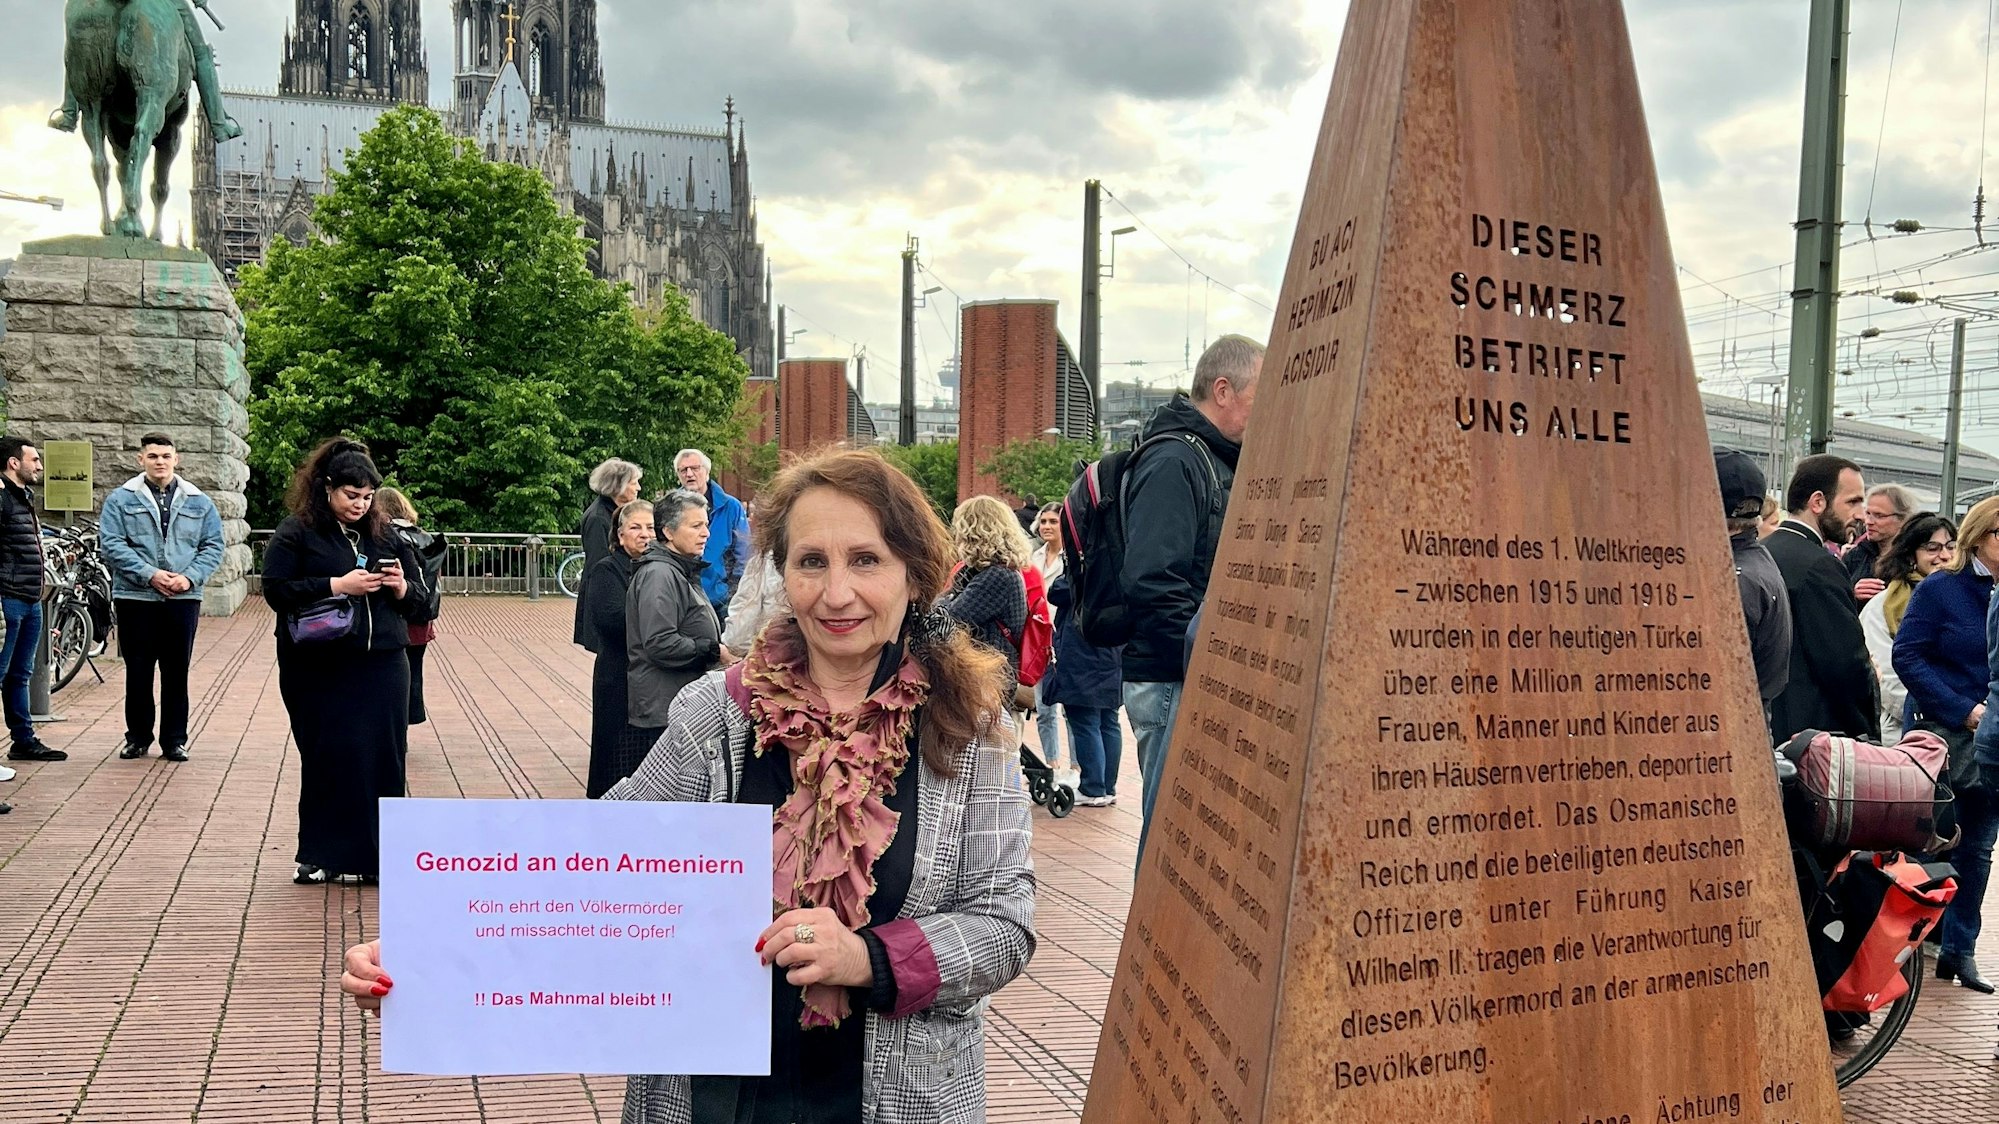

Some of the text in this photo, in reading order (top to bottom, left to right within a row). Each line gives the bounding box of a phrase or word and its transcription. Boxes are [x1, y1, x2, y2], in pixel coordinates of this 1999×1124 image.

[1309, 216, 1357, 270] BU ACI
[1472, 214, 1602, 265] DIESER
[1450, 272, 1626, 327] SCHMERZ
[1280, 339, 1340, 387] ACISIDIR
[1455, 335, 1626, 384] BETRIFFT
[1455, 397, 1631, 443] UNS ALLE
[1401, 528, 1686, 567] Während des 1. Weltkrieges
[1416, 580, 1518, 604] zwischen
[1528, 579, 1577, 605] 1915
[1584, 583, 1621, 605] und
[1630, 583, 1677, 606] 1918
[1390, 623, 1702, 655] wurden in der heutigen Türkei
[1384, 667, 1711, 696] über eine Million armenische
[1378, 711, 1720, 743] Frauen, Männer und Kinder aus
[1371, 751, 1733, 791] ihren Häusern vertrieben, deportiert
[1365, 794, 1736, 840] und ermordet. Das Osmanische
[416, 852, 744, 874] Genozid an den Armeniern
[1360, 836, 1744, 889] Reich und die beteiligten deutschen
[469, 900, 683, 915] Köln ehrt den Völkermörder
[1352, 877, 1753, 939] Offiziere unter Führung Kaiser
[476, 924, 675, 941] und missachtet die Opfer!
[1347, 917, 1762, 989] Wilhelm II. tragen die Verantwortung für
[475, 992, 672, 1006] !! Das Mahnmal bleibt !!
[1341, 958, 1770, 1040] diesen Völkermord an der armenischen
[1335, 1046, 1494, 1090] Bevölkerung.
[1656, 1080, 1794, 1124] Ächtung der
